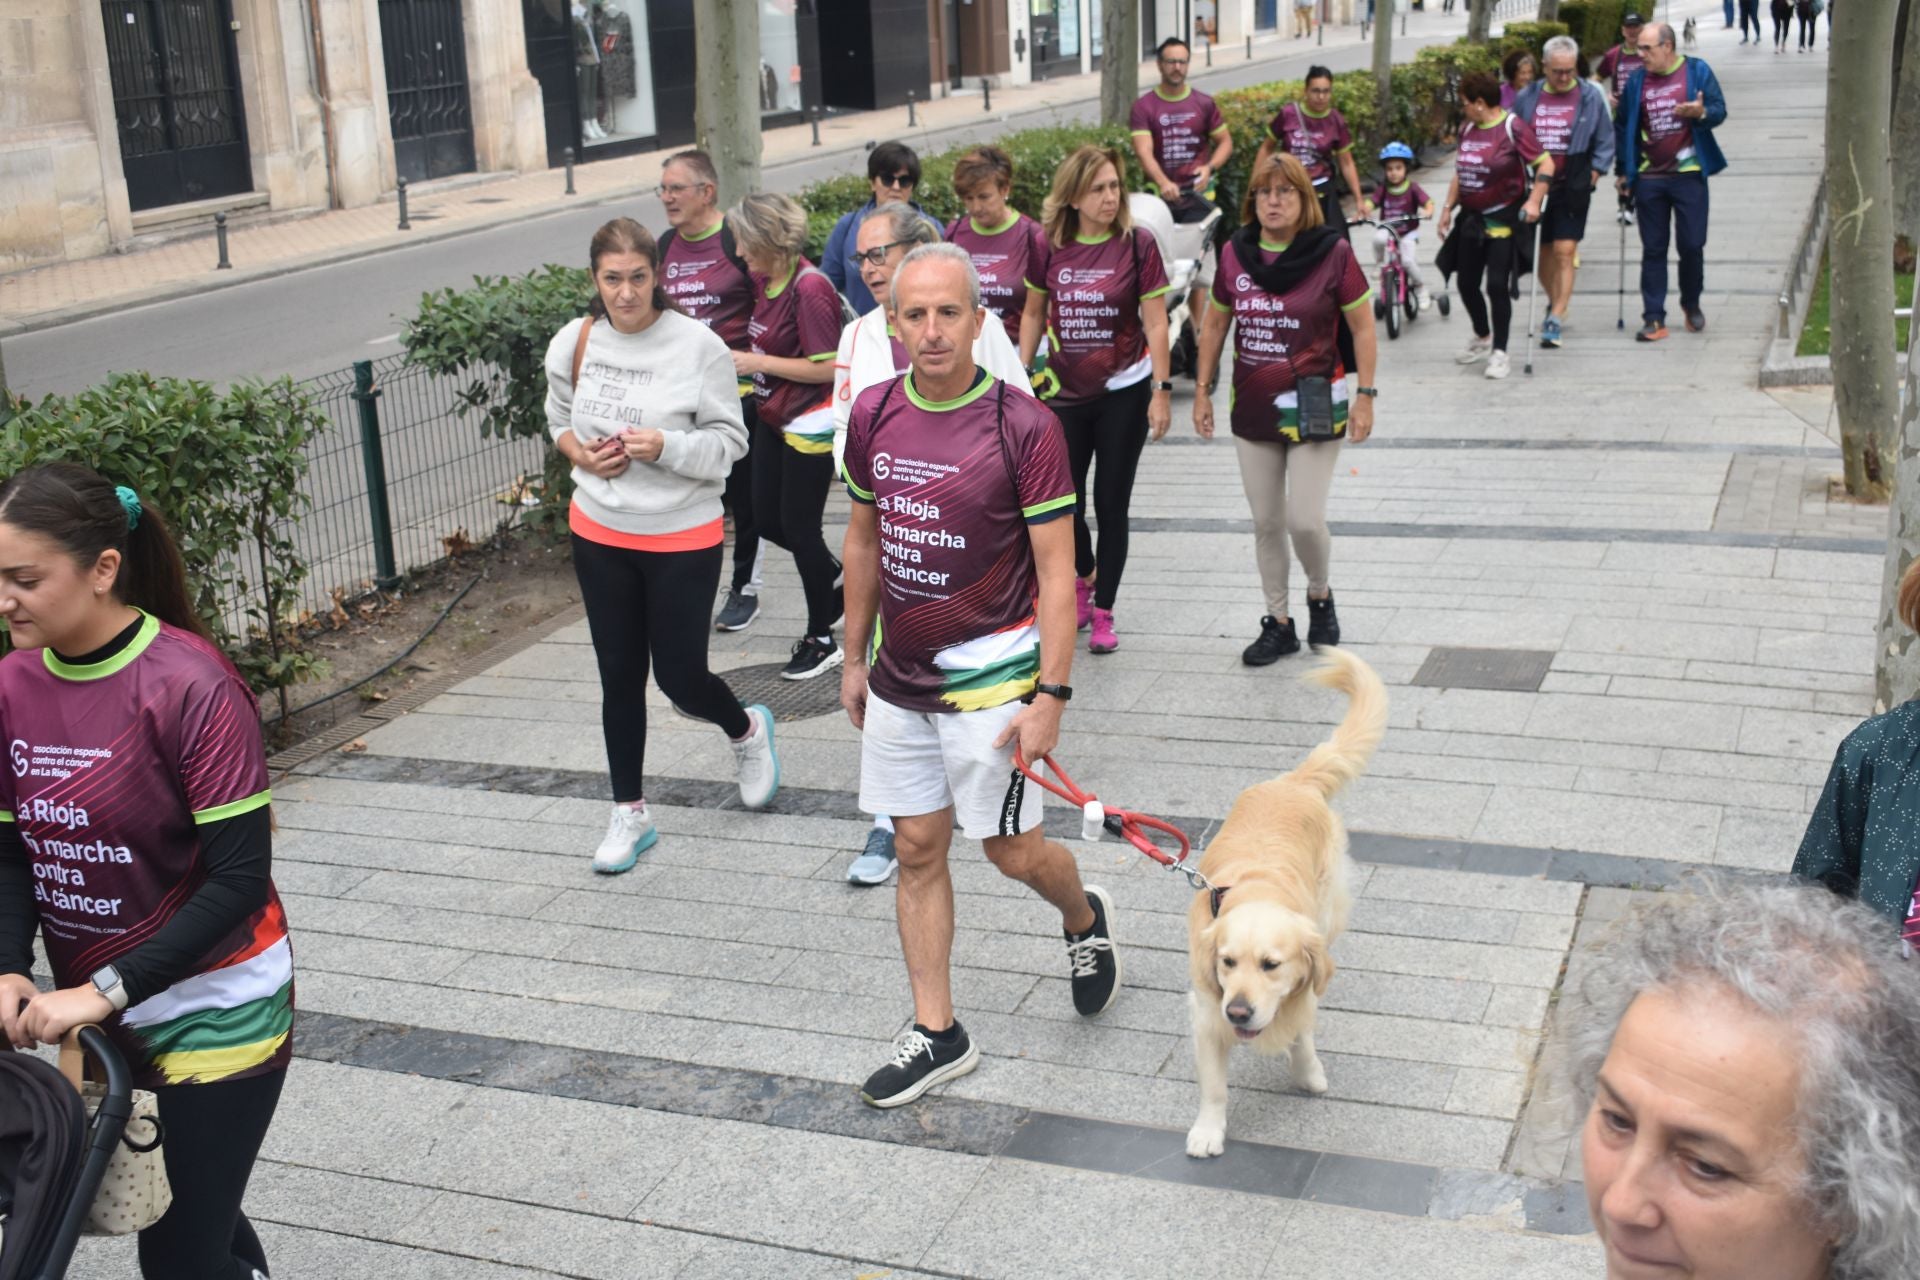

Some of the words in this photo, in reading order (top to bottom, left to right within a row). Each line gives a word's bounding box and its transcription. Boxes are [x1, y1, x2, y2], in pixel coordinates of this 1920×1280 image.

[979, 272, 997, 284] oja
[677, 280, 705, 293] Rioja
[979, 285, 1013, 296] archa
[1057, 289, 1071, 302] La
[1074, 289, 1105, 304] Rioja
[1059, 305, 1073, 317] En
[1075, 304, 1119, 317] marcha
[1235, 298, 1249, 311] La
[1060, 316, 1097, 328] contra
[1060, 328, 1070, 340] el
[1072, 328, 1113, 340] cáncer
[615, 406, 643, 425] MOI
[893, 466, 914, 474] contra
[894, 458, 928, 468] asociación
[929, 462, 960, 473] española
[910, 475, 927, 485] Rioja
[873, 491, 890, 511] La
[894, 495, 940, 521] Rioja
[881, 514, 892, 536] En
[893, 525, 966, 549] marcha
[881, 538, 922, 563] contra
[881, 555, 890, 572] el
[890, 561, 950, 586] cáncer
[33, 744, 72, 755] asociación
[73, 747, 113, 758] española
[32, 756, 55, 765] contra
[57, 757, 65, 766] el
[65, 758, 93, 768] cáncer
[41, 767, 50, 776] La
[52, 768, 72, 780] Rioja
[33, 798, 90, 830] Rioja
[43, 839, 133, 864] marcha
[33, 861, 85, 886] ontra
[52, 887, 122, 916] cáncer
